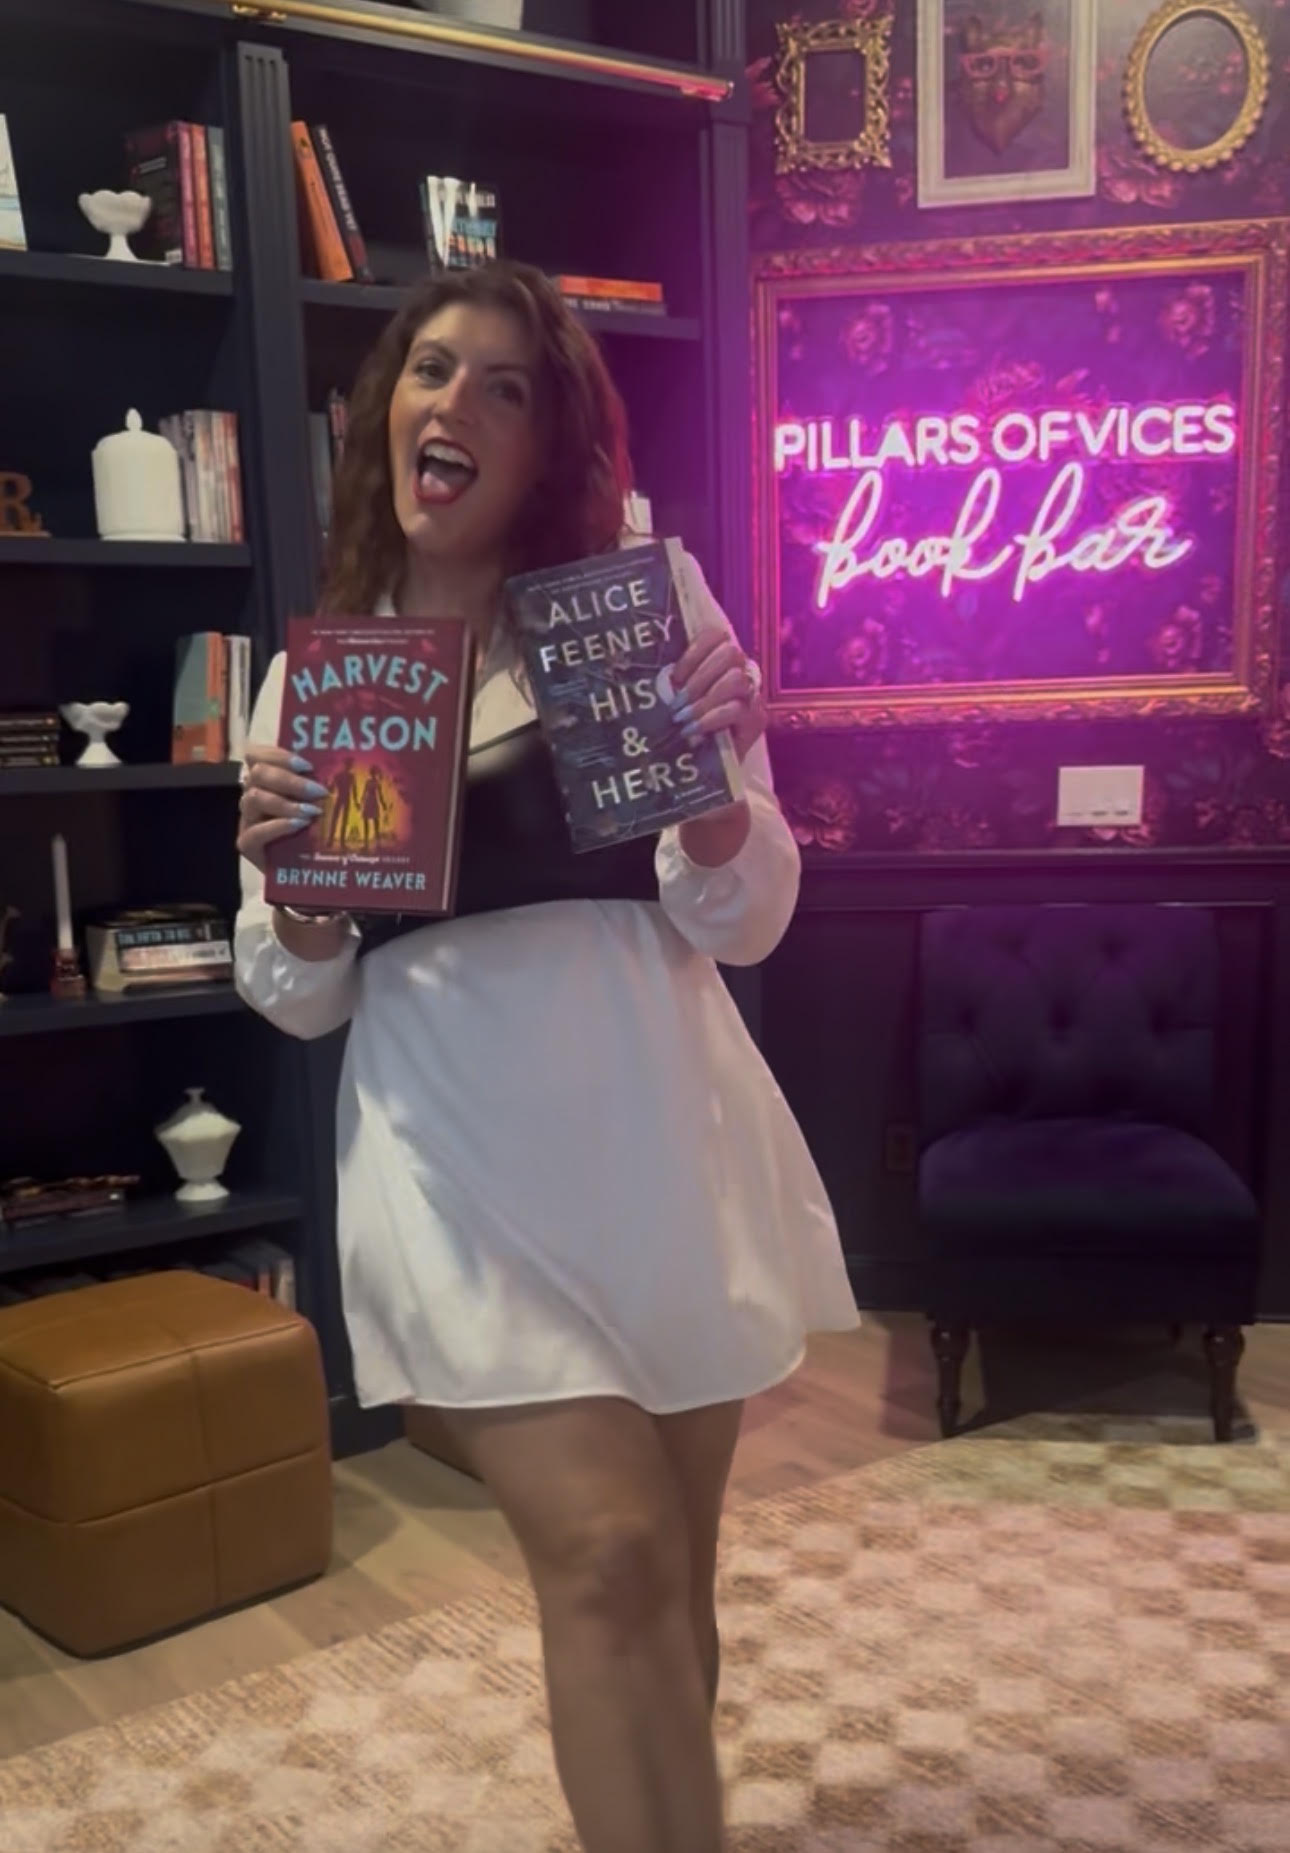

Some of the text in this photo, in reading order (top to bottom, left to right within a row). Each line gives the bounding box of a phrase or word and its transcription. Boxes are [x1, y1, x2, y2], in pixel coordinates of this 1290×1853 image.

[774, 403, 1237, 472] PILLARS OF VICES
[813, 461, 1193, 609] book bar
[549, 579, 651, 629] ALICE
[539, 614, 676, 673] FEENEY
[291, 654, 449, 702] HARVEST
[589, 678, 657, 722] HIS
[292, 715, 437, 751] SEASON
[622, 726, 649, 757] &
[591, 753, 698, 809] HERS
[276, 867, 426, 891] BRYNNE WEAVER
